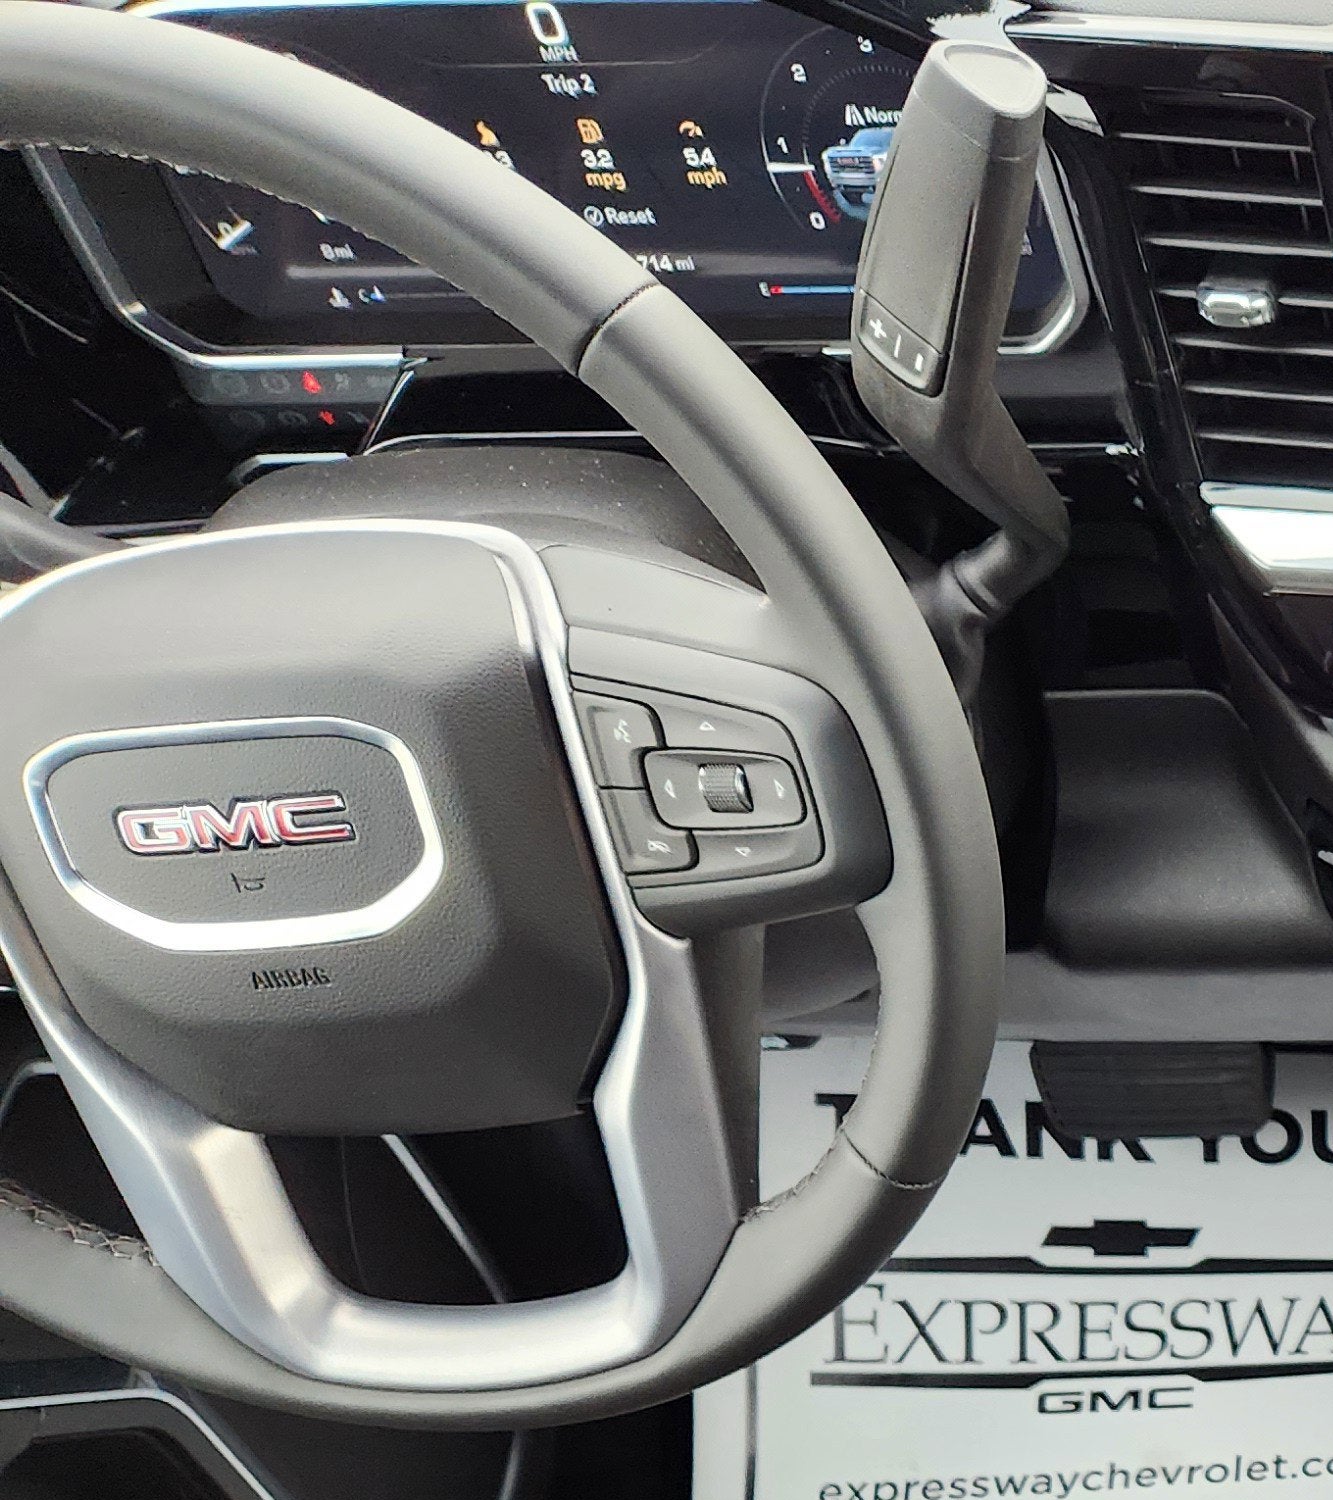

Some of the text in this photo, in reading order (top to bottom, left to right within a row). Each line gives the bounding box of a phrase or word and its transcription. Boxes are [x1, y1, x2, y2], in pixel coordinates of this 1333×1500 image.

[525, 2, 570, 46] 0
[538, 46, 580, 63] MPH
[790, 63, 807, 82] 2
[541, 73, 599, 99] Trip 2
[776, 136, 789, 154] 1
[585, 172, 628, 192] mpg
[686, 168, 728, 189] mph
[605, 207, 657, 226] Reset
[808, 211, 826, 231] 0
[116, 793, 356, 856] GMC
[251, 967, 331, 990] AIRBAG
[1037, 1387, 1195, 1414] GMC
